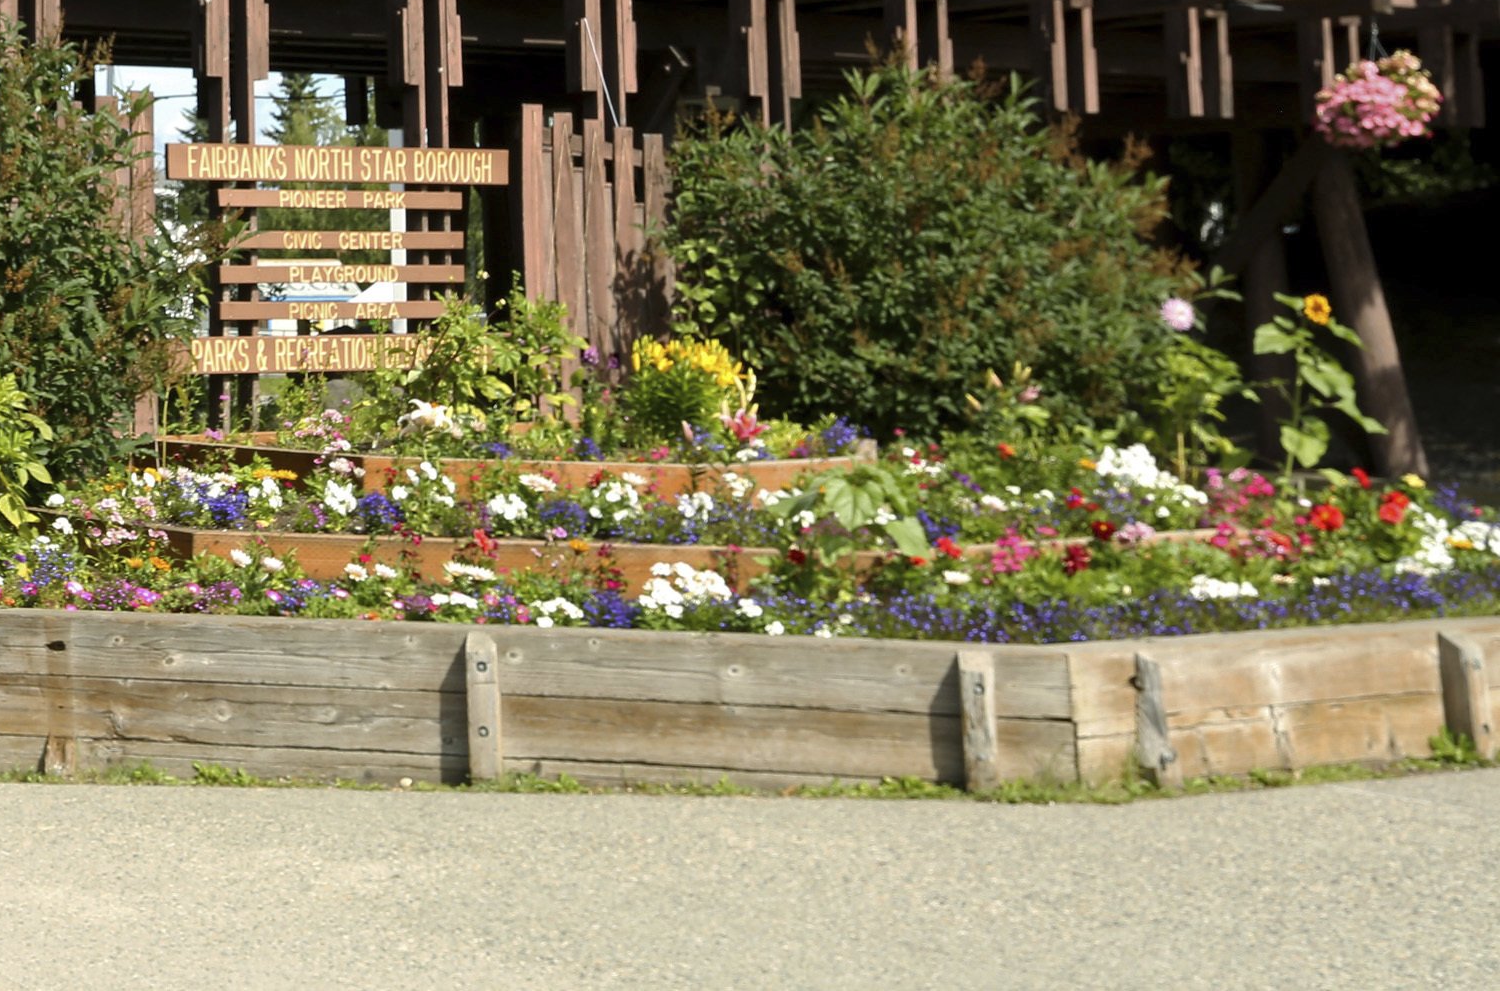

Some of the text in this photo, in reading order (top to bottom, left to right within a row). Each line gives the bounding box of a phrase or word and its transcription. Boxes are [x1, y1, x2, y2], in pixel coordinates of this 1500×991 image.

[187, 145, 492, 184] FAIRBANKS NORTH STAR BOROUGH
[279, 190, 406, 209] PIONEER PARK
[283, 233, 403, 250] CIVIC CENTER
[289, 265, 399, 283] PLAYGROUND
[289, 302, 400, 320] PICNIC AREA
[192, 338, 249, 372] PARKS
[256, 338, 268, 371] &
